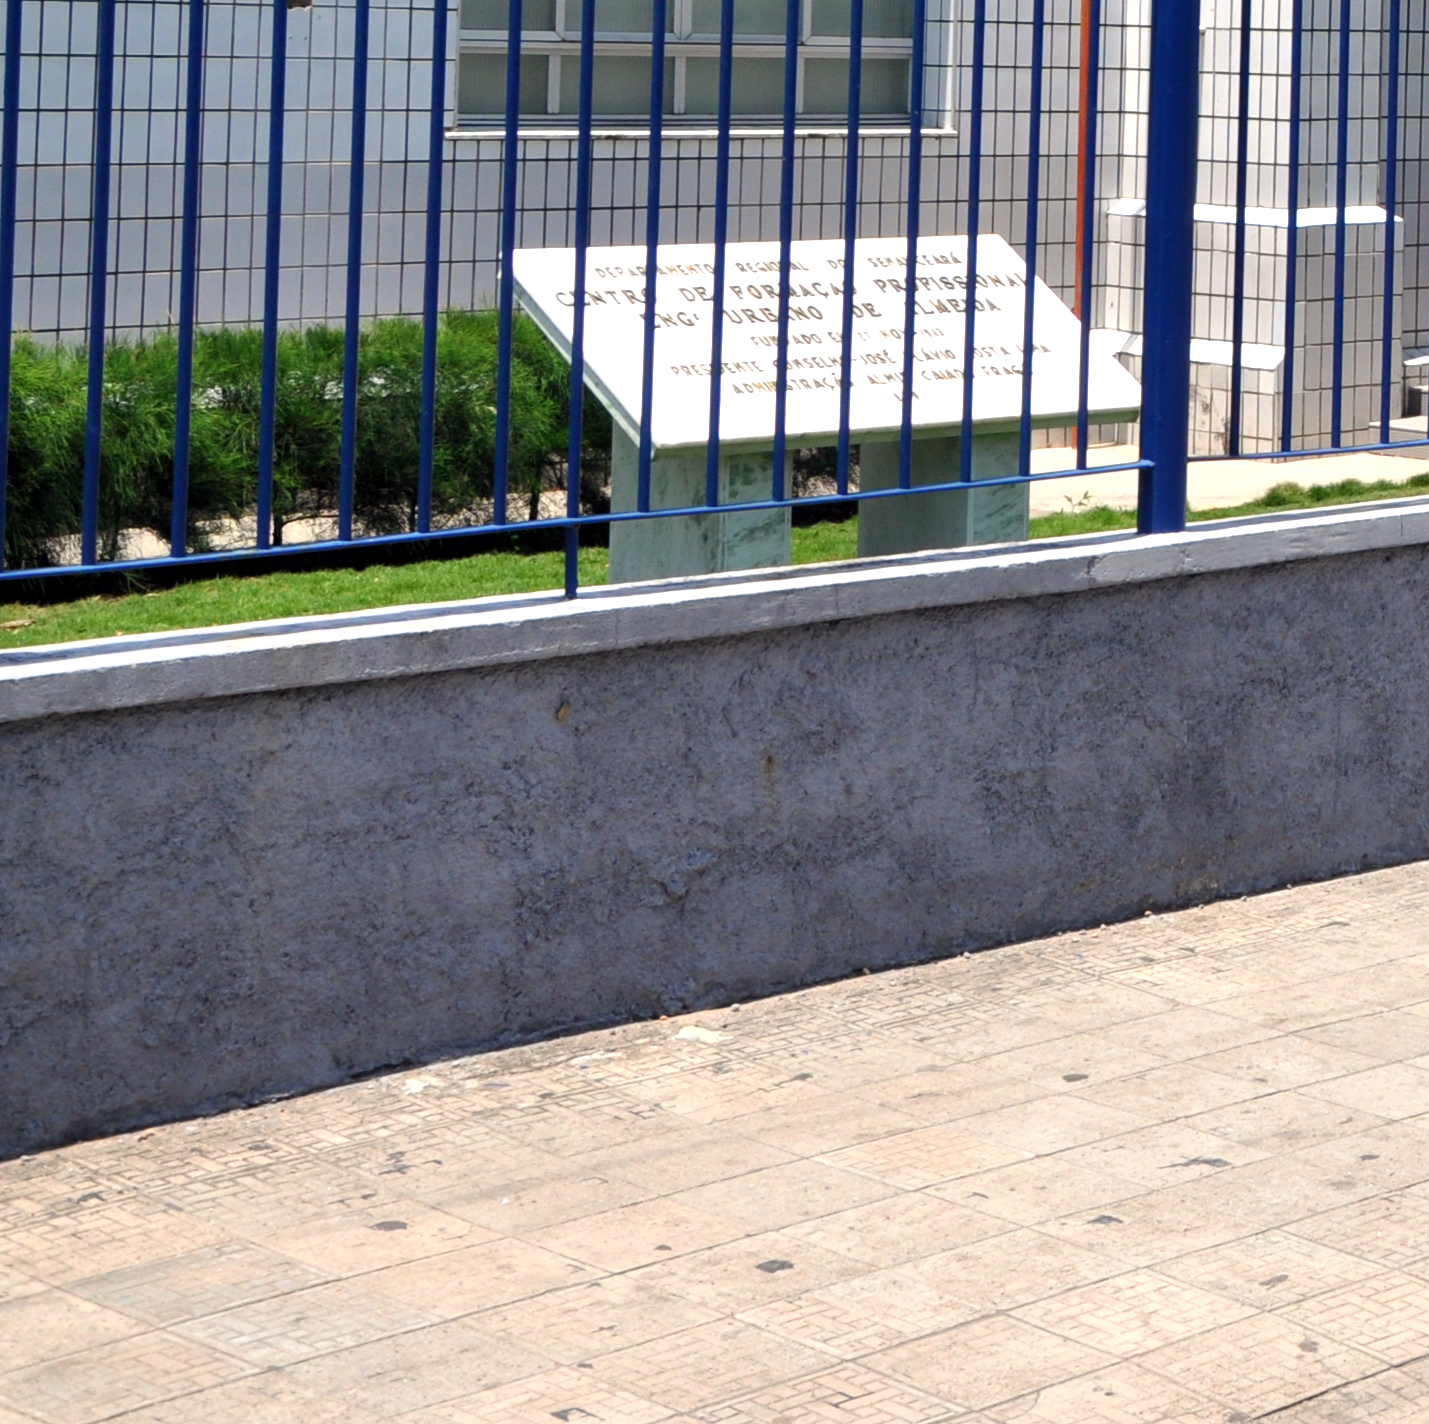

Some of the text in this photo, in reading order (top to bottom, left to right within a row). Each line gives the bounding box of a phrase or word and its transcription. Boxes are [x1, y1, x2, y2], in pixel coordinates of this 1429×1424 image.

[595, 263, 717, 279] DEPARAMENTO
[735, 260, 811, 274] REGIOAL
[678, 286, 716, 302] DE
[729, 280, 857, 301] FORMAÇÃ
[873, 273, 1027, 294] PRFISSONAL
[722, 306, 824, 325] URBNO
[850, 303, 882, 318] DE
[904, 298, 1001, 316] LMEDA
[750, 333, 822, 348] FUNADO
[670, 360, 764, 376] PRESENTE
[904, 348, 957, 363] LÁVIO
[732, 372, 854, 394] ADMINSTRAÇÃ
